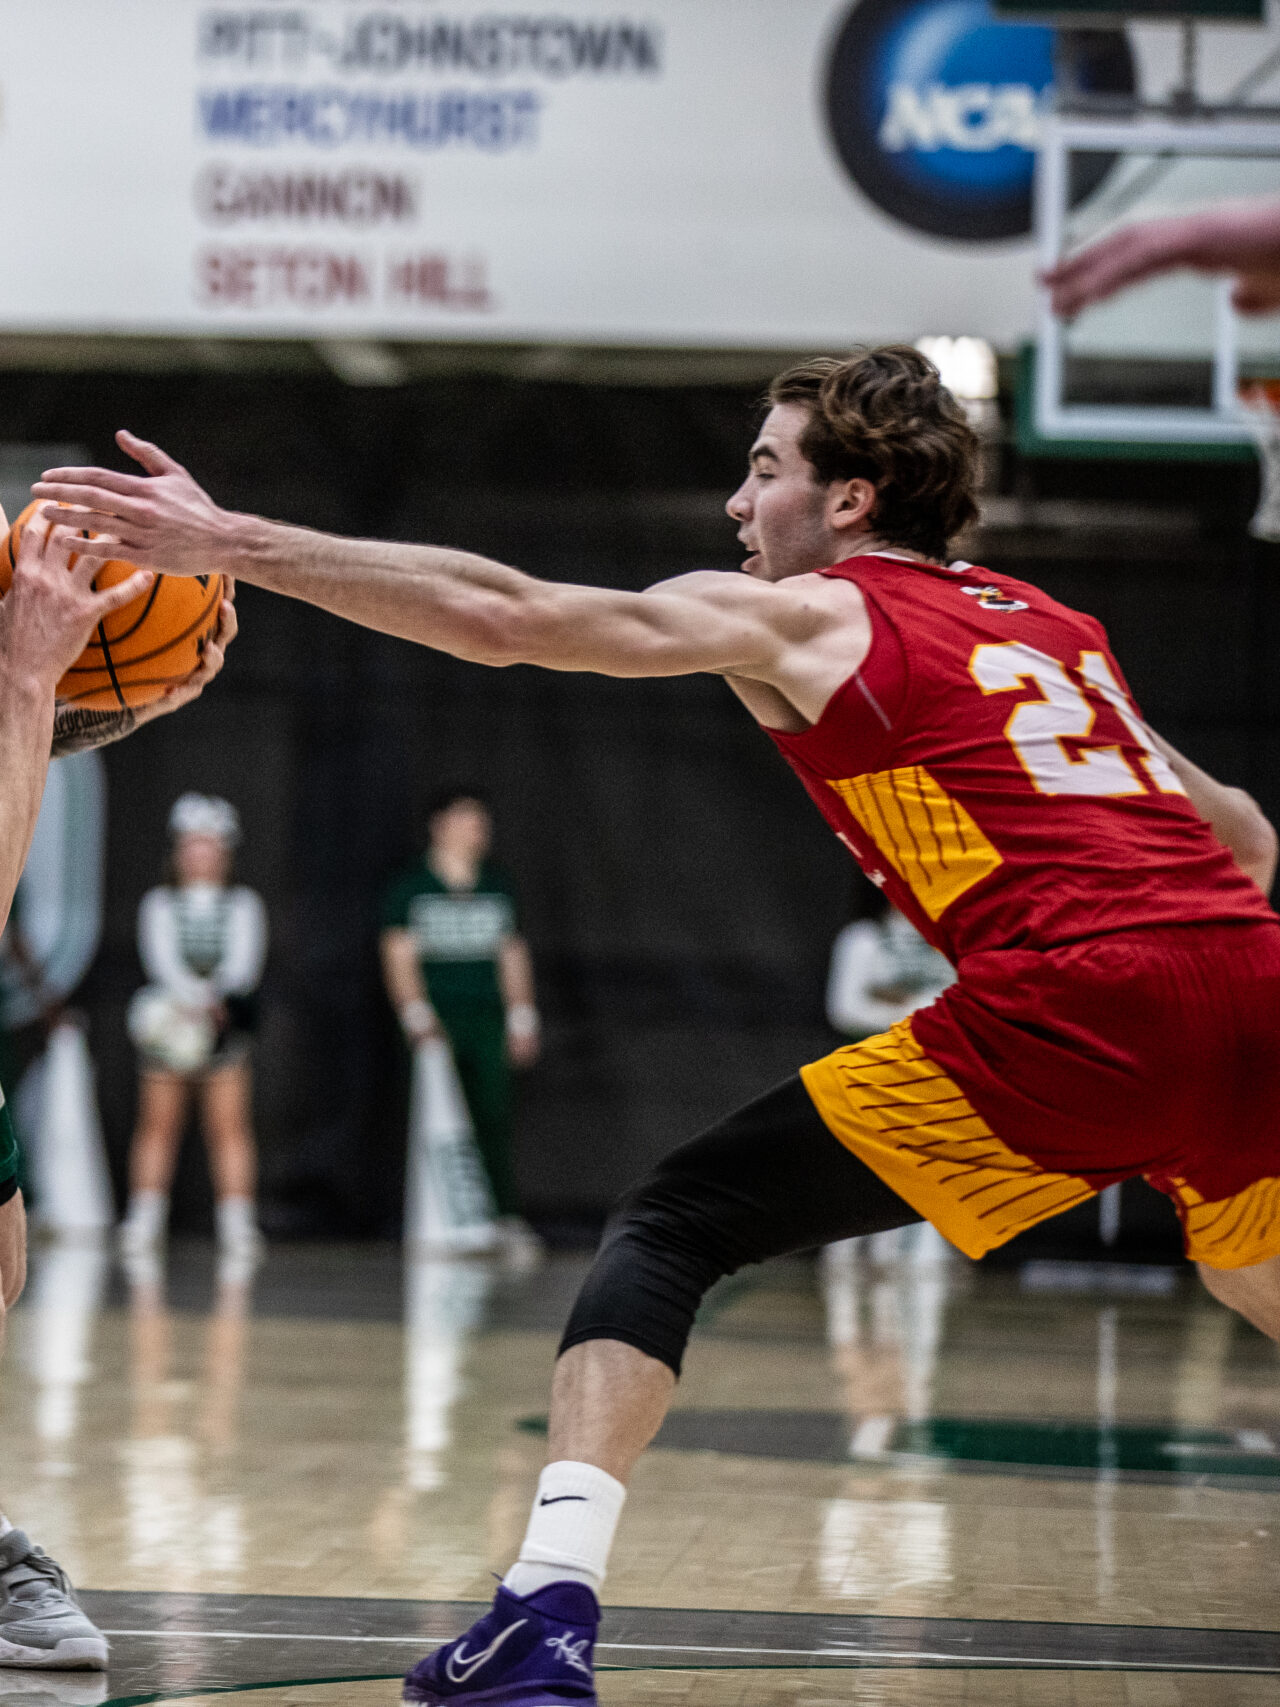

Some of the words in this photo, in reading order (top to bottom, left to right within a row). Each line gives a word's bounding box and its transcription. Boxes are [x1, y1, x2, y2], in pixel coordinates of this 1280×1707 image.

[202, 9, 660, 75] PITT-JOHNSTOWN
[199, 86, 538, 150] MERCYHURST
[880, 82, 1054, 152] NCA
[200, 163, 418, 227] GANNON
[199, 245, 370, 307] SETON
[386, 251, 494, 312] HILL
[968, 640, 1188, 797] 21
